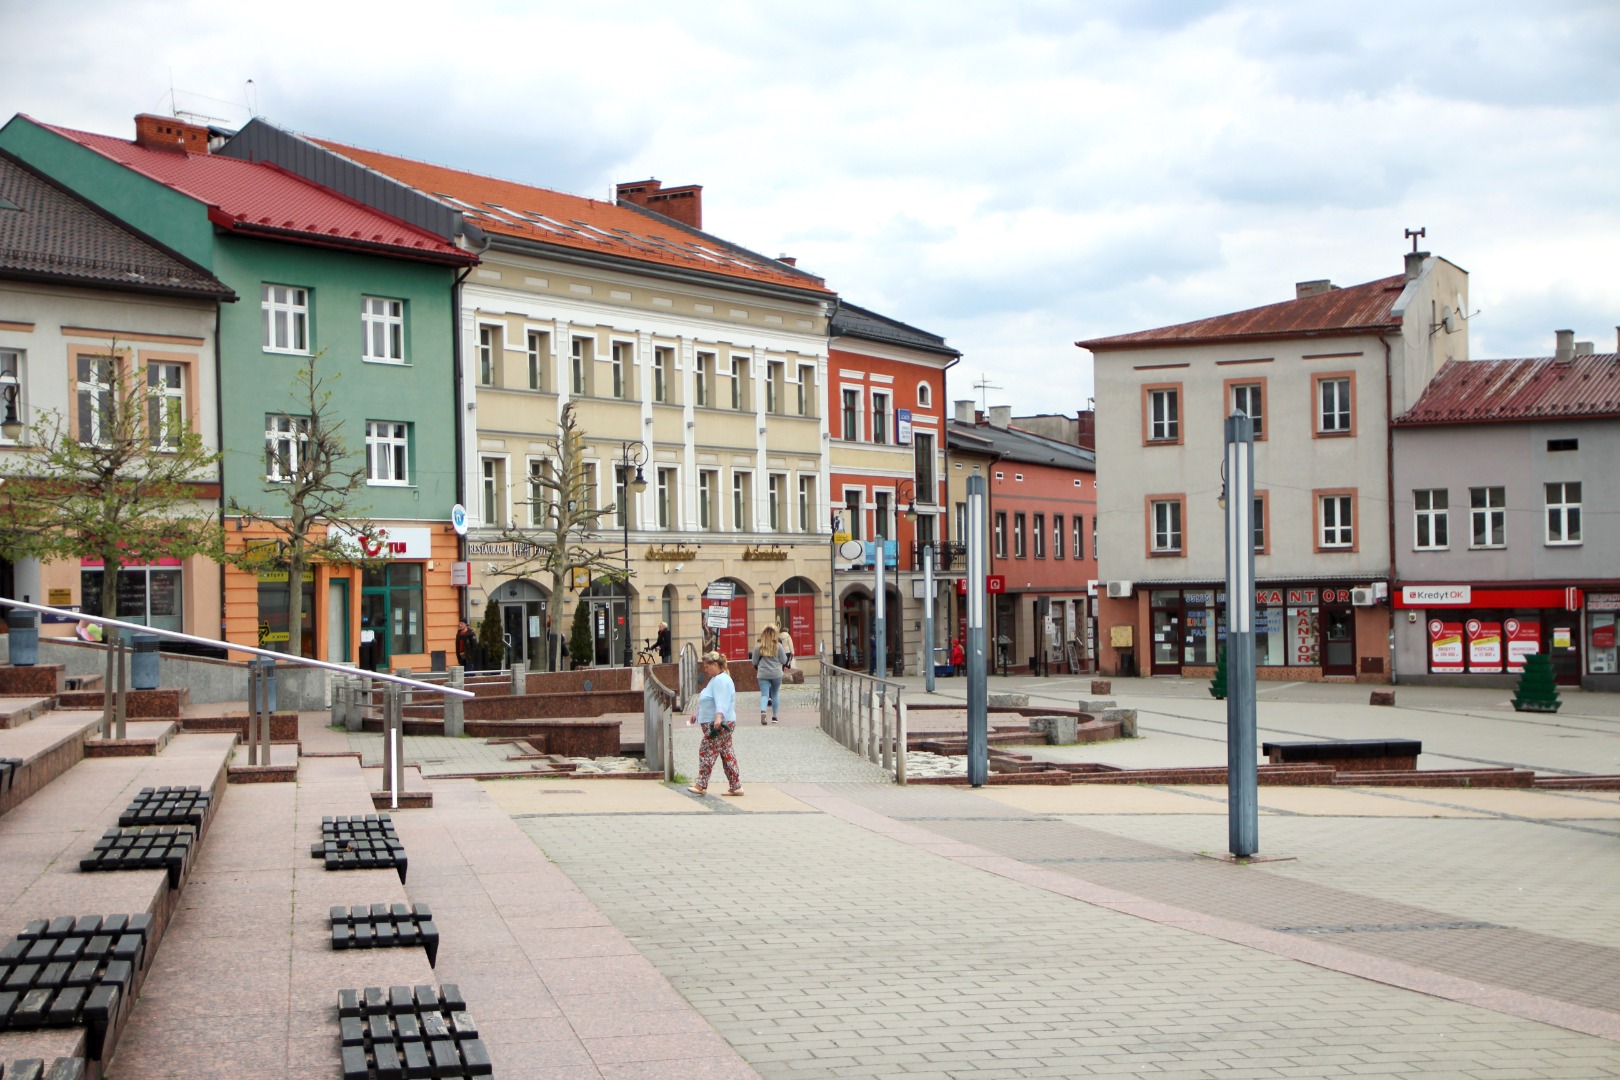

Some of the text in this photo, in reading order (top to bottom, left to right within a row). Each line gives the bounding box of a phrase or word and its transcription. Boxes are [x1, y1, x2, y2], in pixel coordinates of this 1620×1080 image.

[388, 542, 407, 554] TUI
[469, 544, 511, 555] RESTAURACJA
[1418, 592, 1448, 600] Kredyt
[1297, 609, 1311, 663] KANTOR
